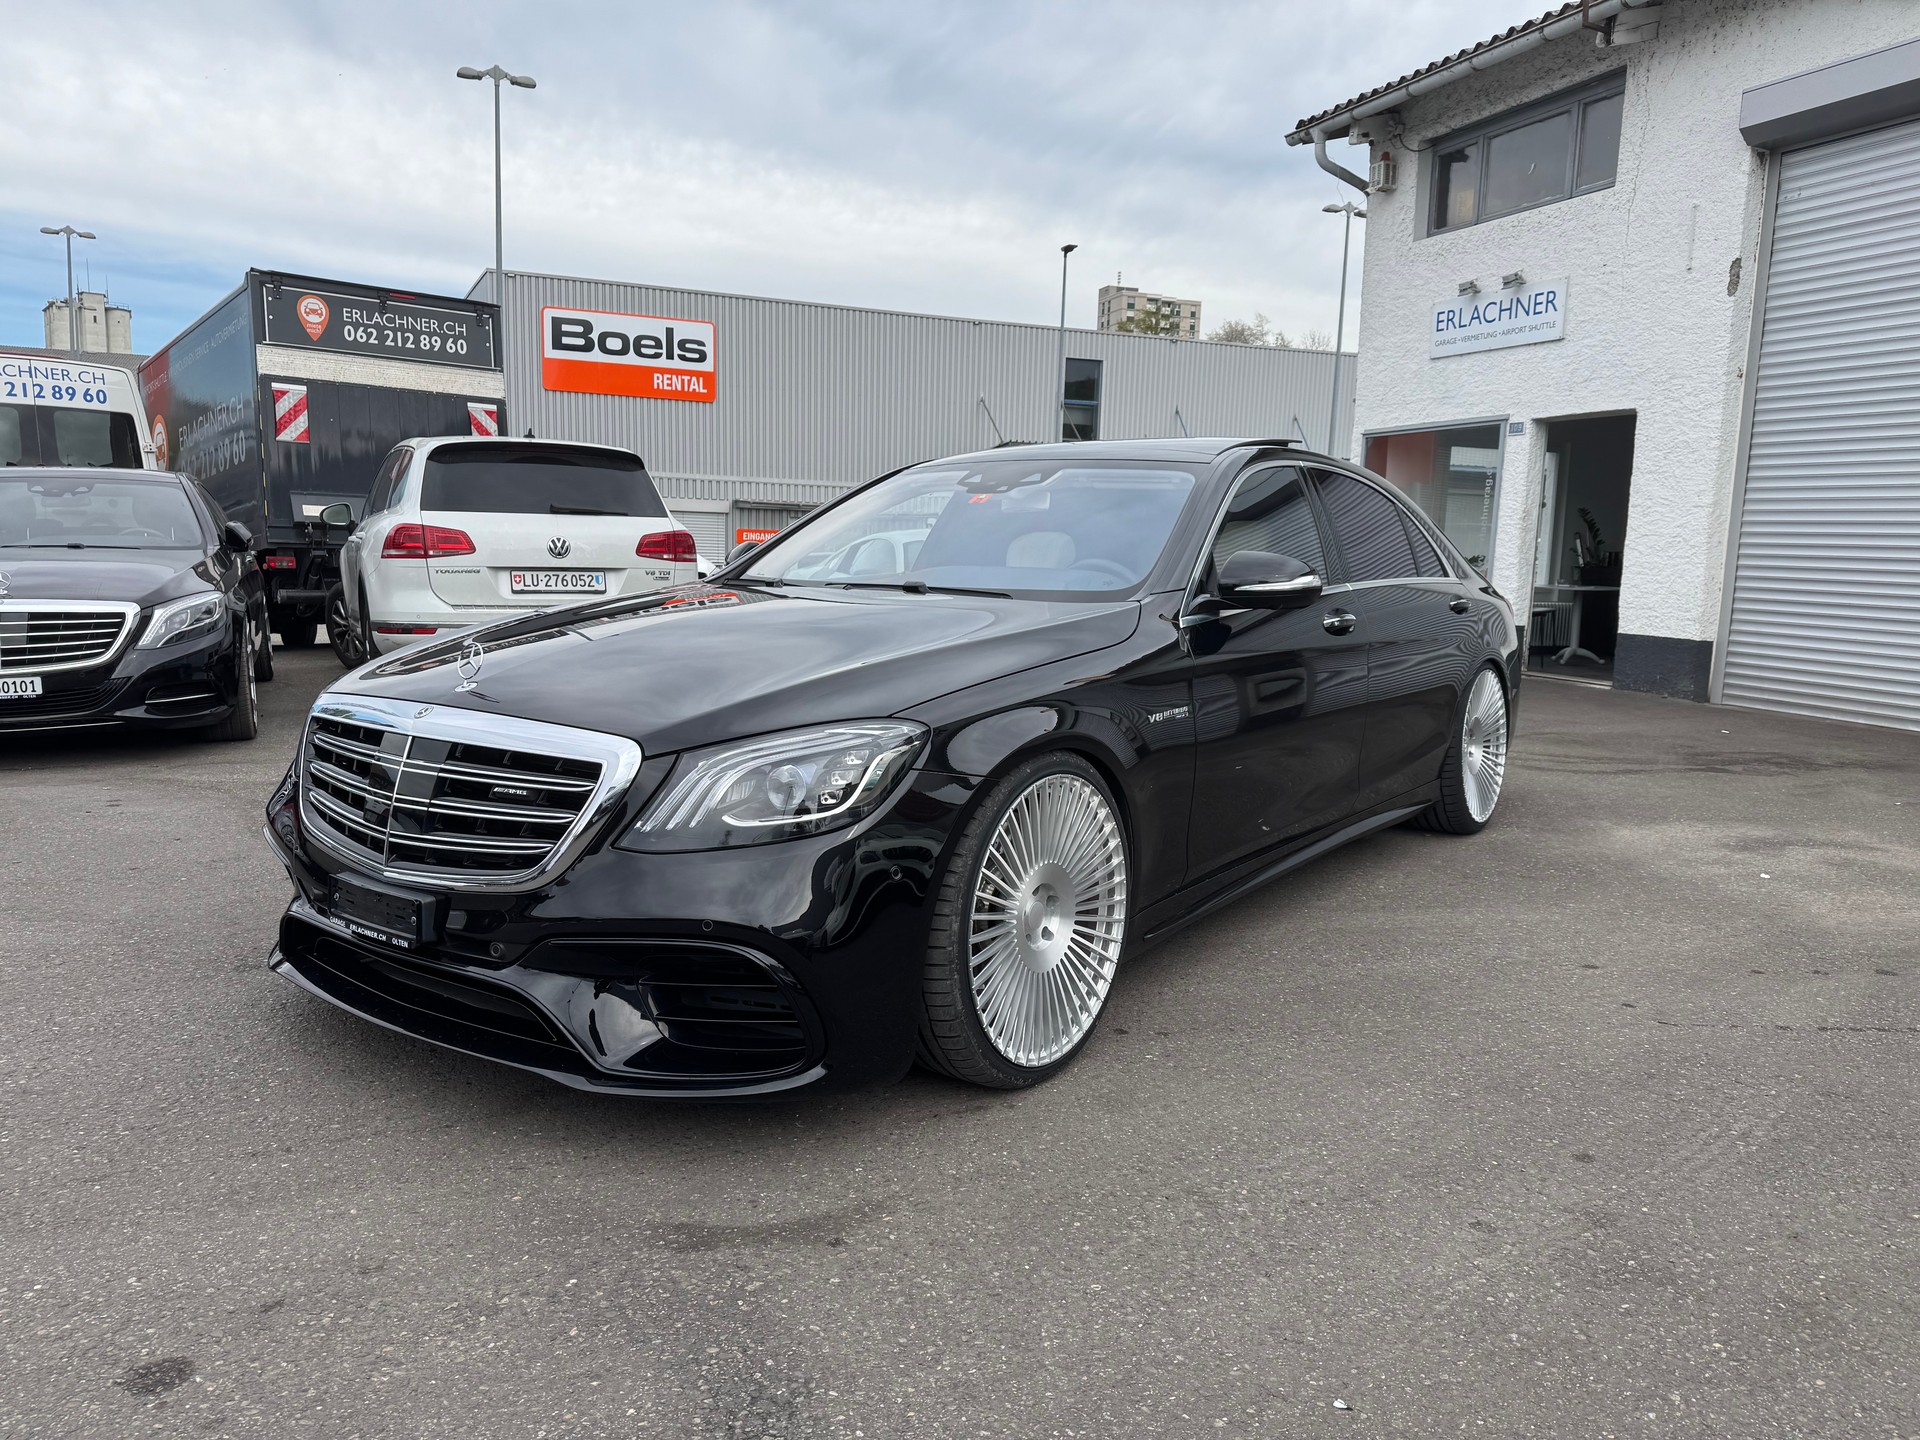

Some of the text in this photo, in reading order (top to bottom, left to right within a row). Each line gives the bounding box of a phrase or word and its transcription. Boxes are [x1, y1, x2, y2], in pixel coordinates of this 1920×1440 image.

[343, 308, 467, 336] ERLACHNER.CH
[1436, 290, 1558, 332] ERLACHNER
[343, 325, 467, 354] 062 212 89 60
[551, 316, 707, 363] Boels
[1434, 321, 1557, 347] GARAGE VERMIETUNG AIRPORT SHUTTLE
[4, 381, 108, 405] 212 89 60
[653, 373, 708, 393] RENTAL
[178, 392, 244, 450] ERLACHNER.CH
[218, 437, 230, 472] 89
[233, 429, 246, 466] 60
[0, 680, 37, 694] 0101
[1148, 713, 1163, 723] V8
[349, 924, 387, 941] ERLACHNER.CH
[391, 937, 409, 948] OLTEN
